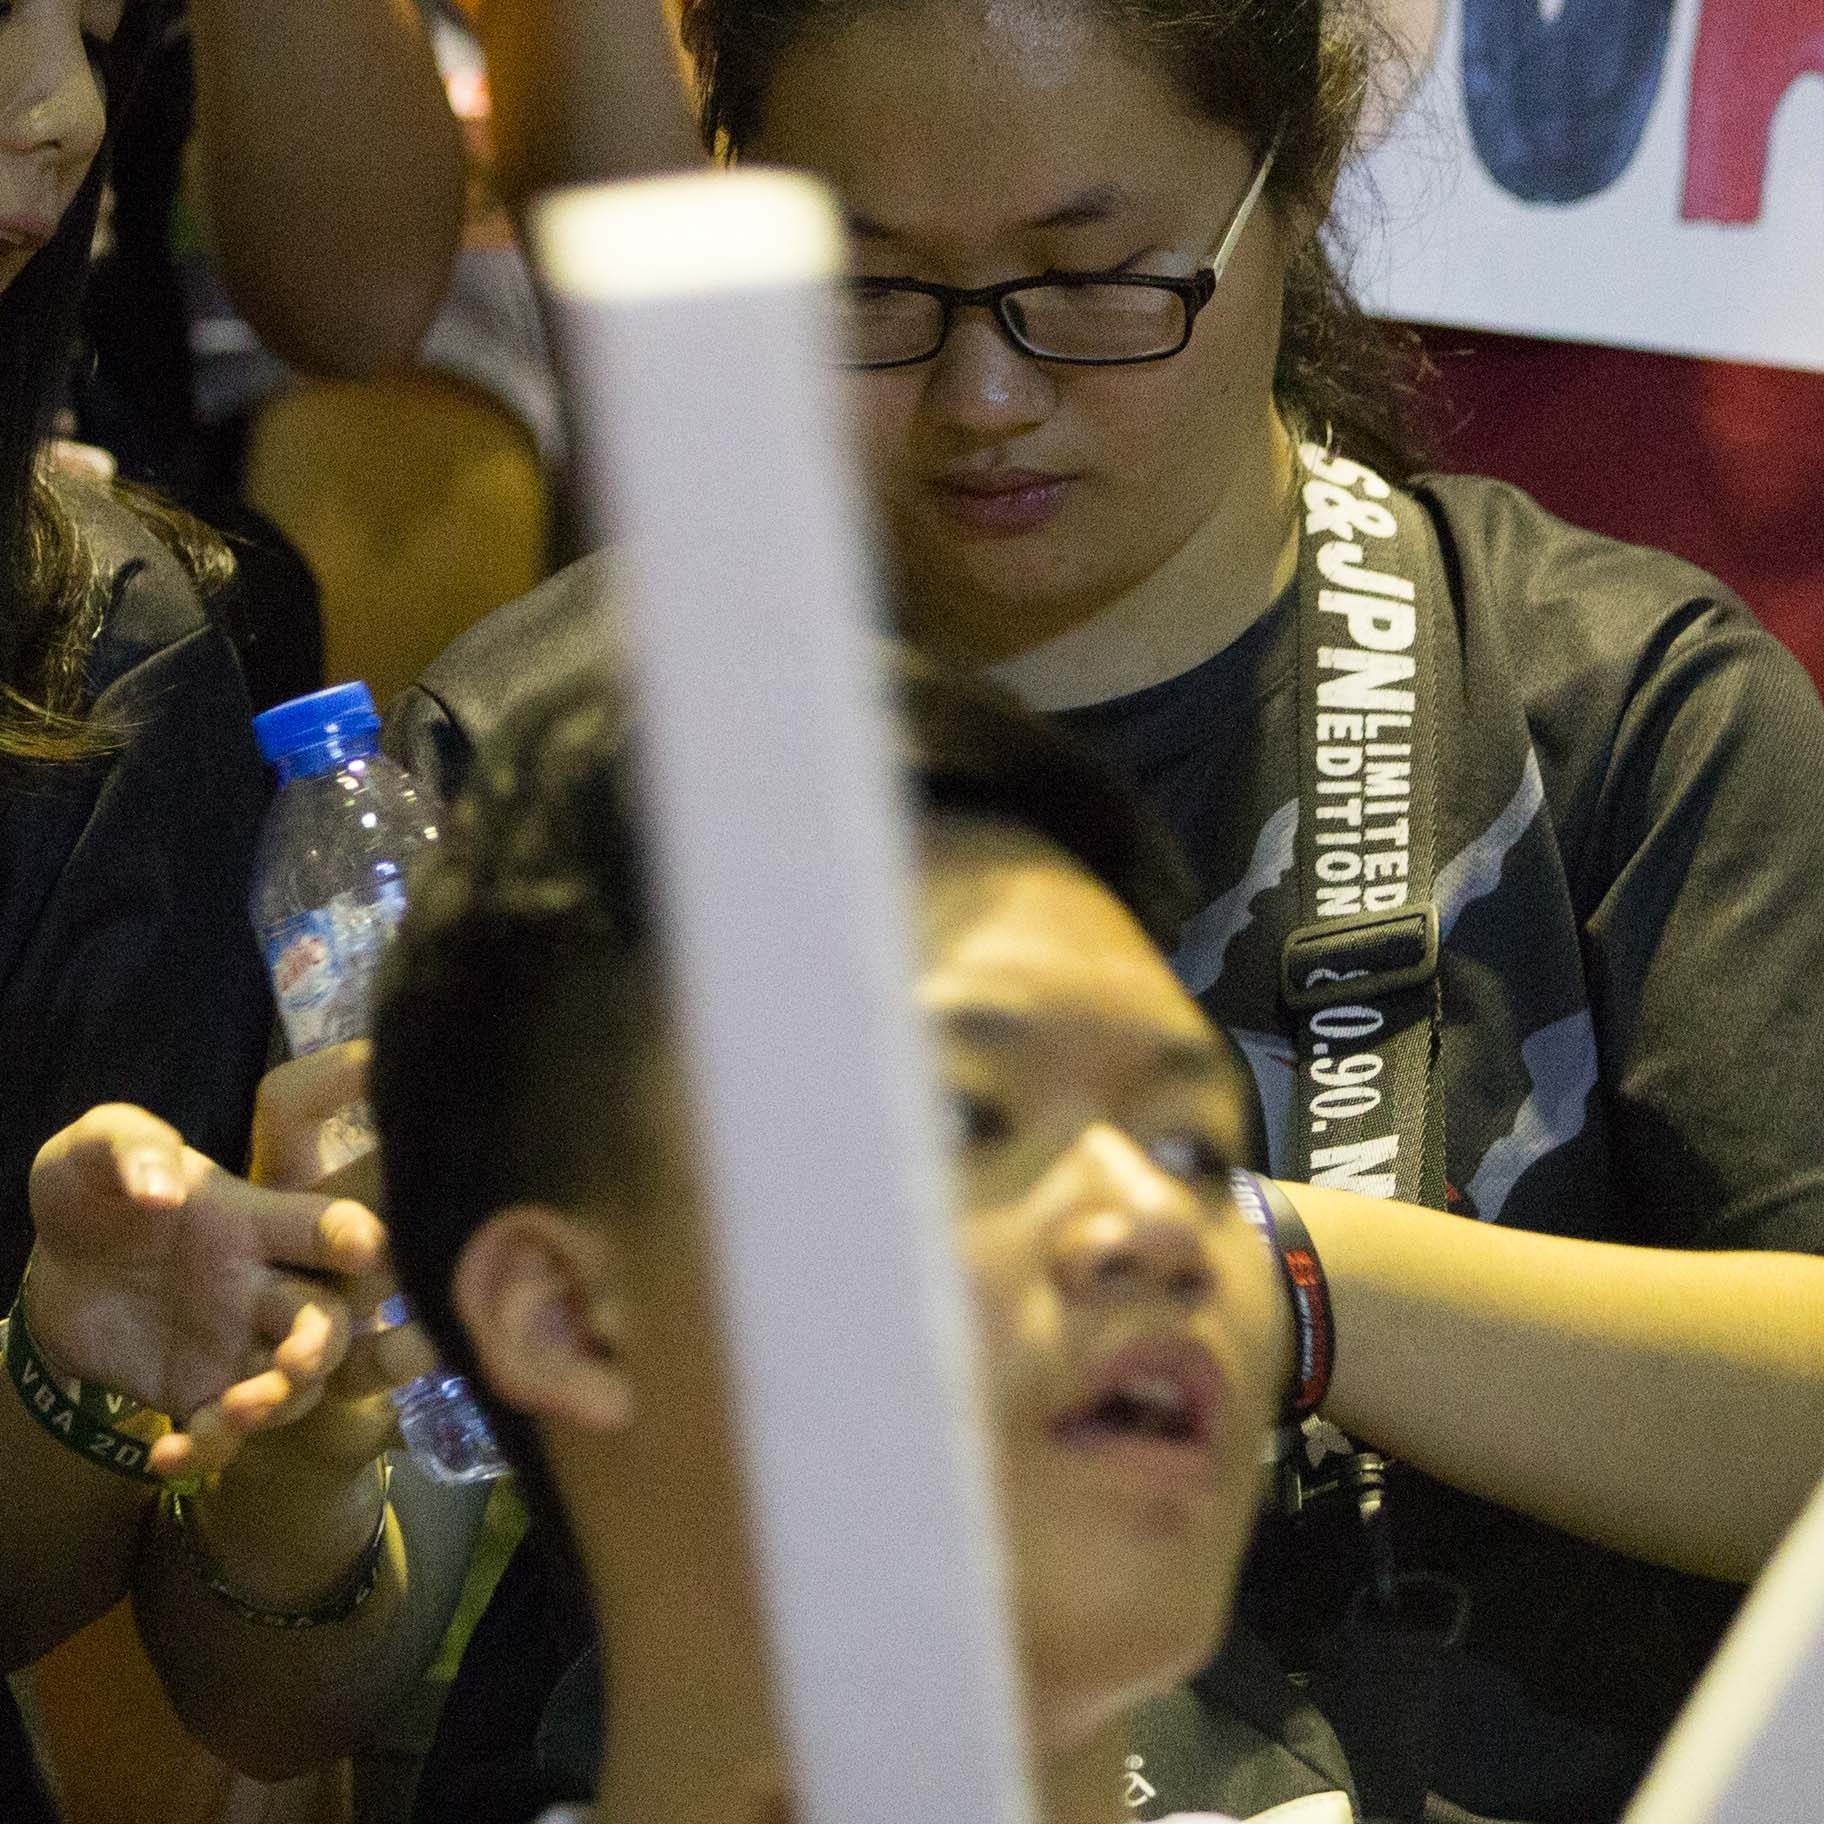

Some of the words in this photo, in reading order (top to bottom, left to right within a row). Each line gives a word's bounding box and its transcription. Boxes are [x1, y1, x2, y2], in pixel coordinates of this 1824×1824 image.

[1314, 712, 1363, 918] EDITION
[1362, 710, 1413, 914] LIMITED
[21, 1357, 75, 1435] VBA
